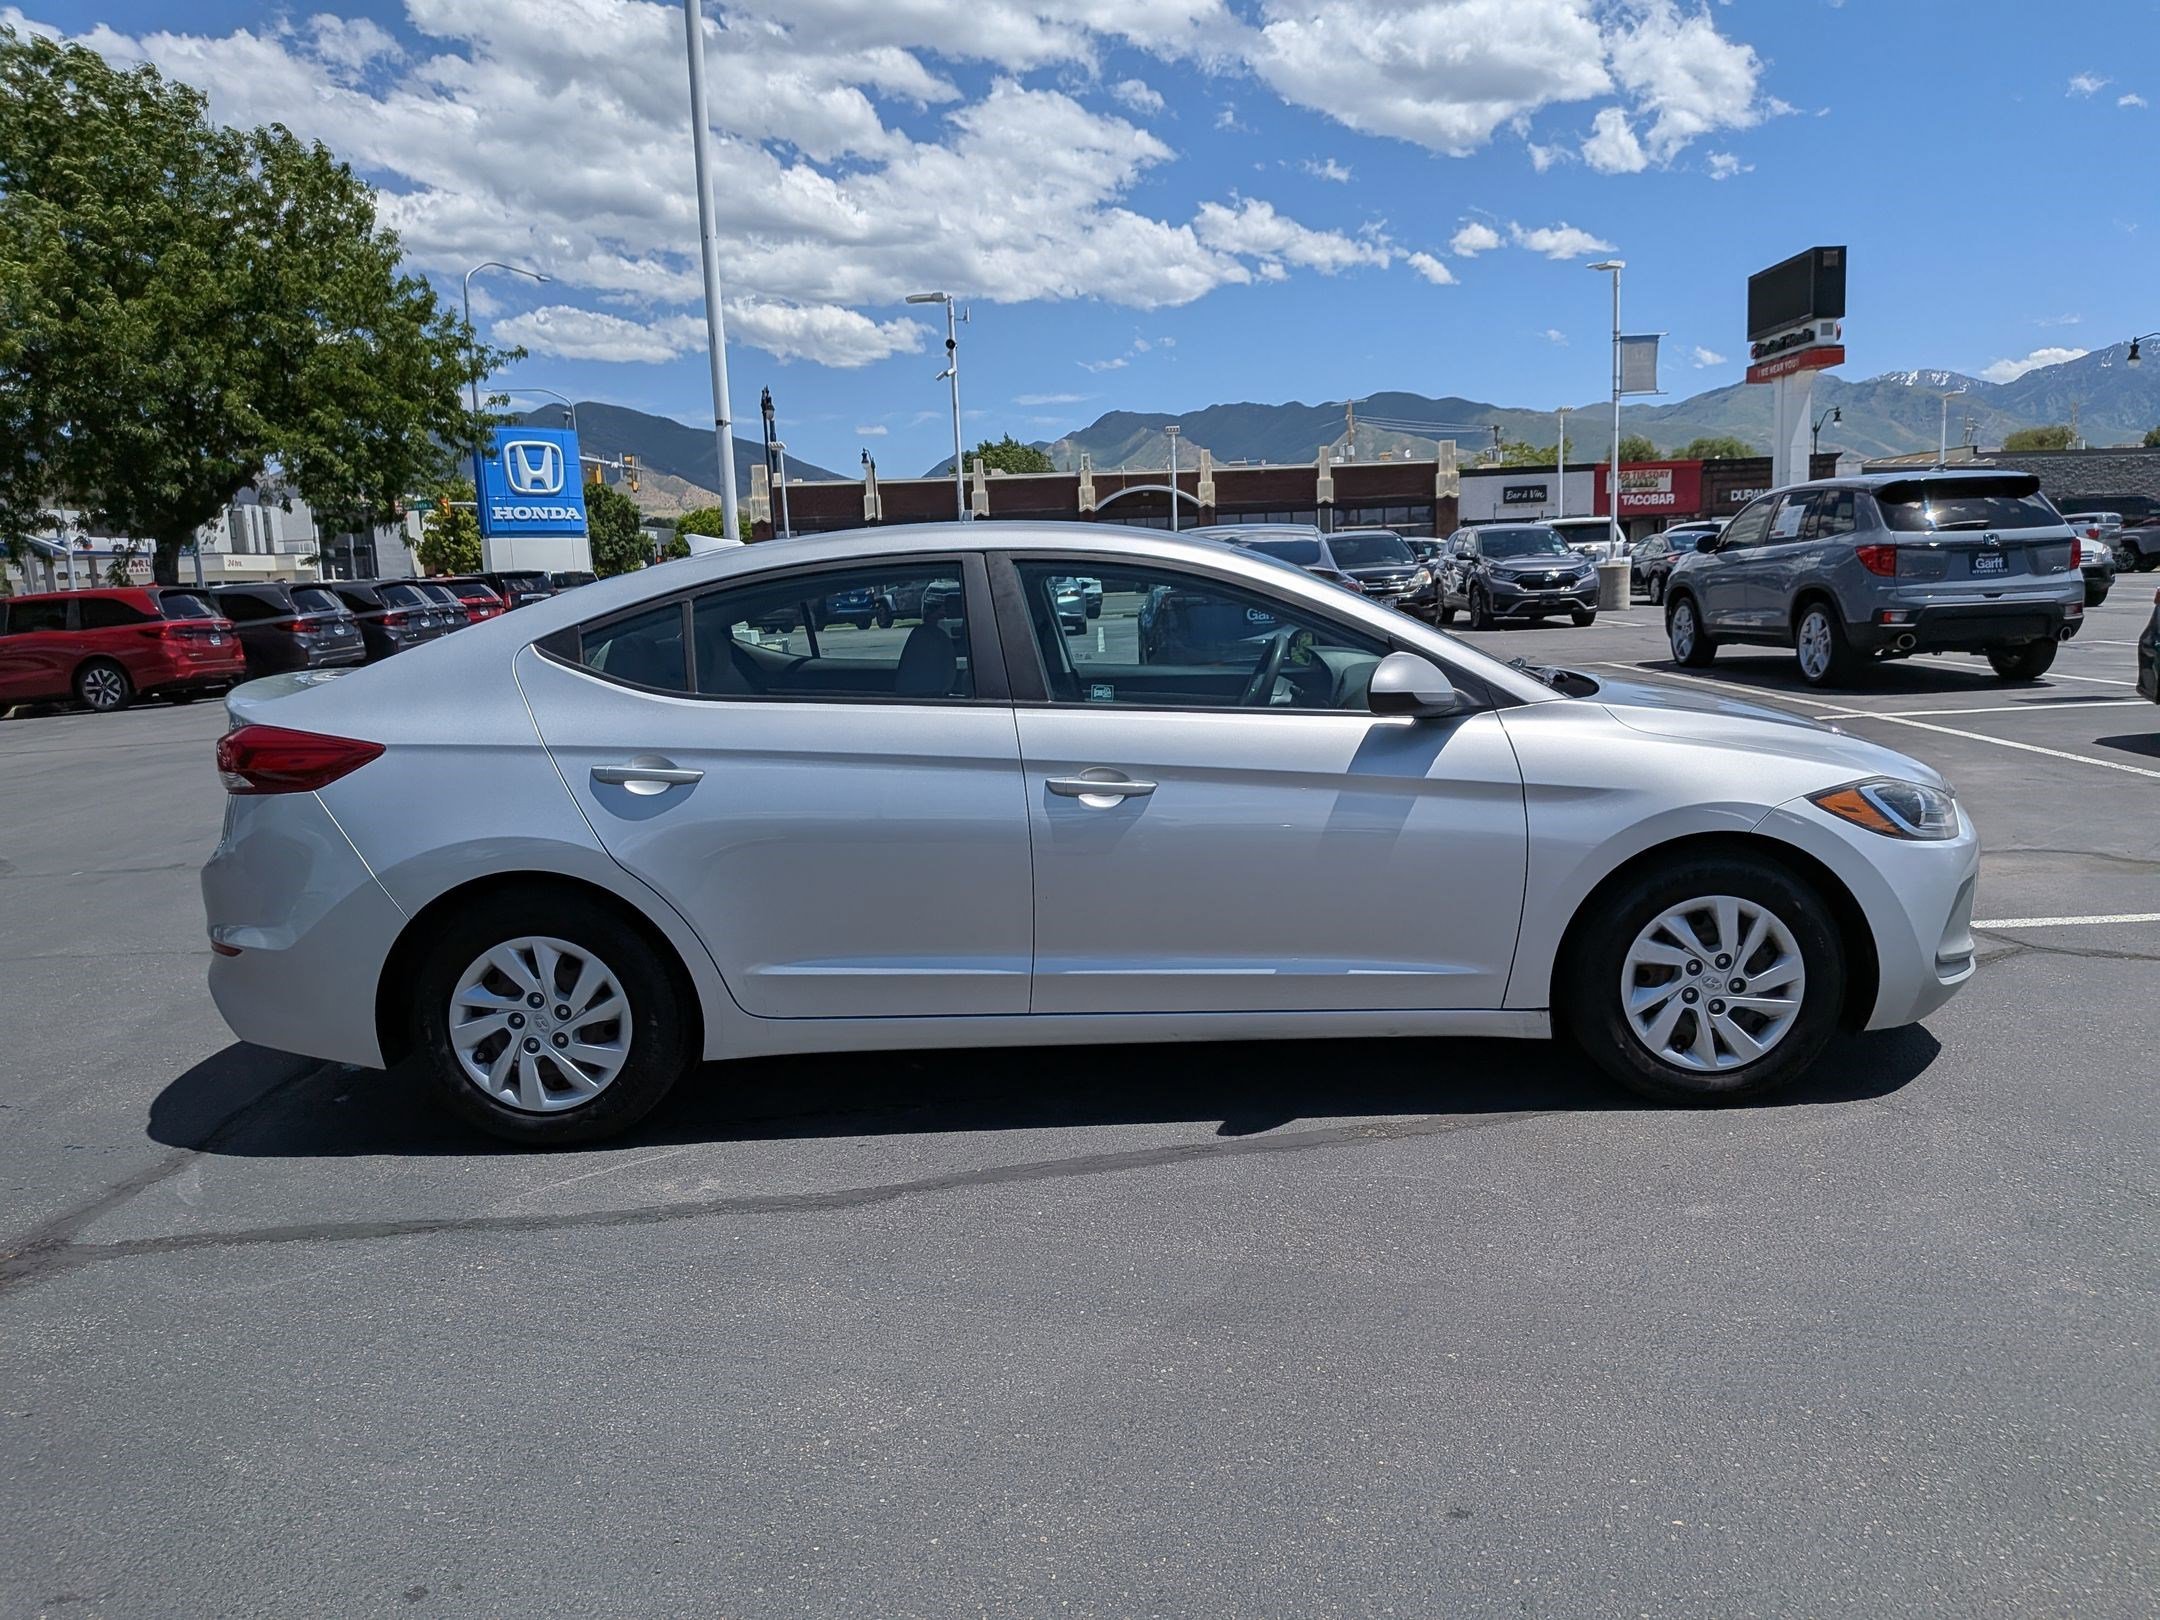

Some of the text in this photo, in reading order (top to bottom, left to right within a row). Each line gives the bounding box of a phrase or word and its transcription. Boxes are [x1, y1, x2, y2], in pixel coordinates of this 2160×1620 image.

[1506, 491, 1521, 500] Bar
[1621, 493, 1675, 505] TACOBAR
[492, 506, 582, 520] HONDA
[1975, 557, 2003, 569] Garff
